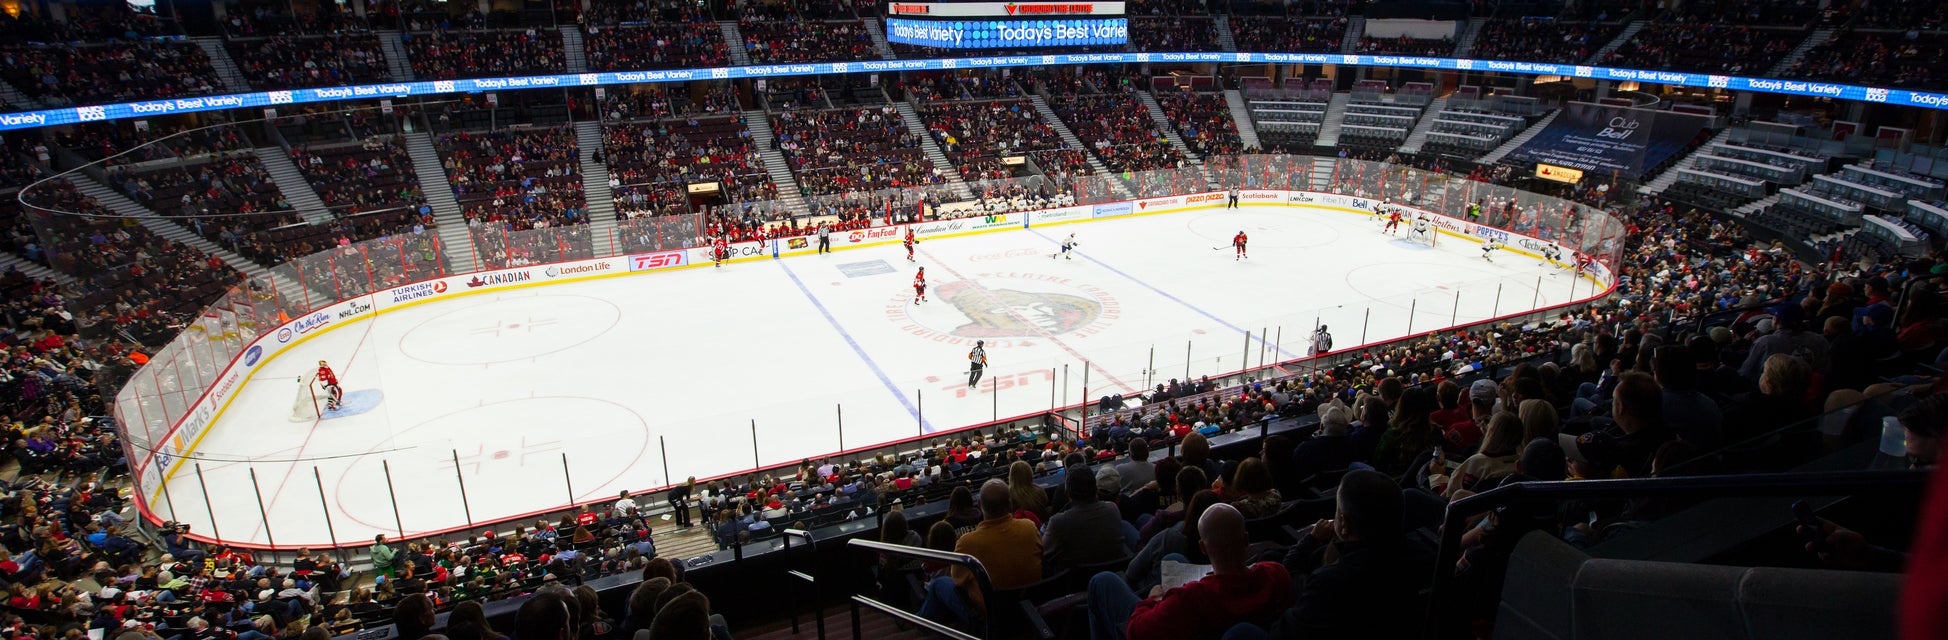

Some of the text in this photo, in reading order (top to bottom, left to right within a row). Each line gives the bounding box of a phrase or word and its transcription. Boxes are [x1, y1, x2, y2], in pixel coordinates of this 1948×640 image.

[893, 23, 963, 45] Today's Best Variety
[997, 25, 1052, 43] Today's
[1056, 24, 1089, 39] Best
[617, 73, 645, 81] Today's
[1610, 69, 1686, 82] Today's Best Variety
[475, 79, 507, 88] Today's
[510, 78, 530, 86] Best
[1750, 79, 1842, 95] Today's Best Variety
[316, 84, 411, 97] Today's Best Variety
[131, 96, 242, 112] Today's Best Variety
[1912, 93, 1948, 106] Today's
[0, 114, 44, 124] Variety
[1609, 116, 1640, 129] Club
[1597, 127, 1633, 140] Bell
[1186, 193, 1224, 205] pizza pizza
[1352, 199, 1368, 209] Bell
[985, 215, 1007, 224] WM
[1432, 216, 1460, 232] Hortons
[915, 221, 963, 235] Canadian Club
[1477, 226, 1510, 241] POPEYE'S
[635, 253, 681, 269] TSN
[560, 262, 611, 275] London Life
[482, 270, 530, 286] CANADIAN
[391, 282, 432, 296] TURKISH
[393, 289, 434, 303] AIRLINES
[339, 303, 371, 319] NHL.COM
[305, 317, 315, 328] the
[314, 312, 331, 324] Run
[216, 371, 239, 400] Scotiabank
[180, 405, 210, 446] Mark's
